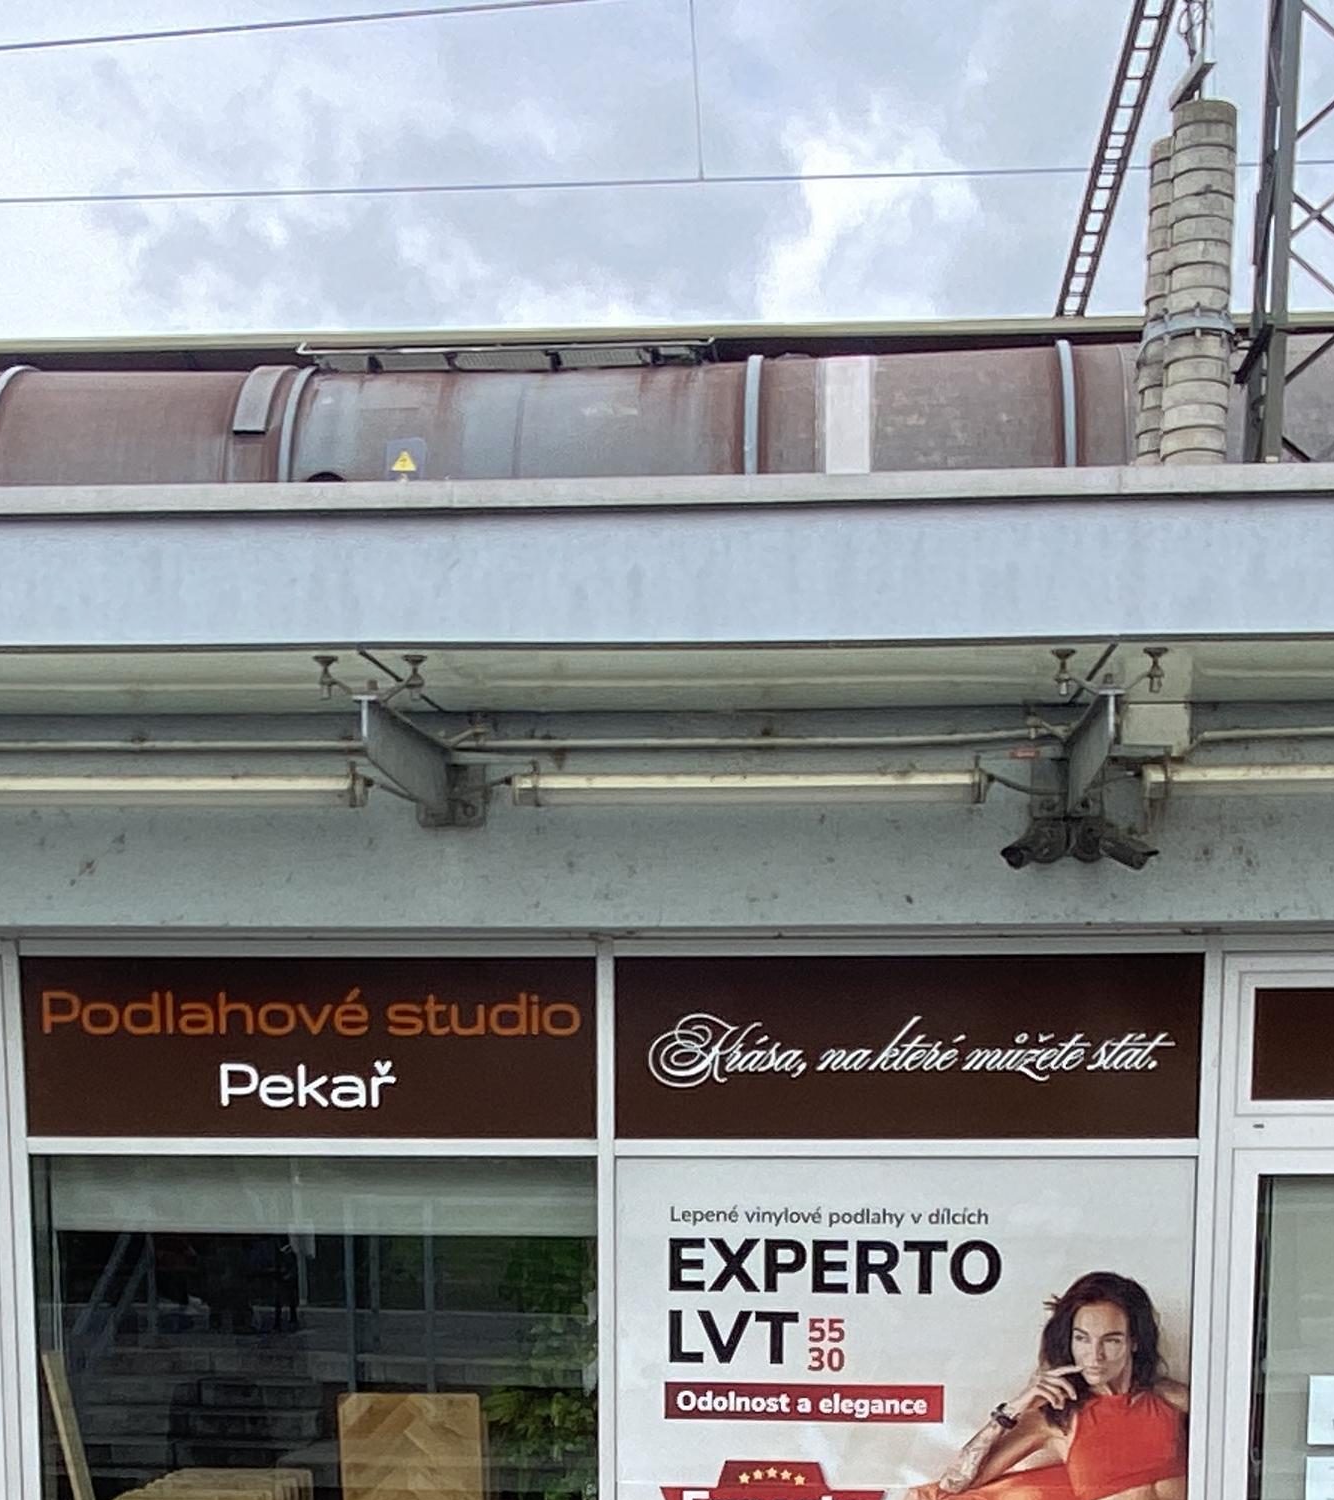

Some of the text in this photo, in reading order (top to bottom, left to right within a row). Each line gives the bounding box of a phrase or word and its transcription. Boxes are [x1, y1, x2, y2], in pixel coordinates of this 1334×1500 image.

[41, 987, 581, 1037] Podlahové studio
[649, 1012, 1176, 1088] Krása, na které můžete stát.
[219, 1060, 397, 1109] Pekař
[670, 1205, 989, 1229] Lepené vinylové podlahy v dílcích
[668, 1238, 1002, 1295] EXPERTO
[668, 1310, 799, 1364] LVT
[807, 1317, 846, 1343] 55
[807, 1347, 846, 1373] 30
[676, 1389, 927, 1418] Odolnost a elegance
